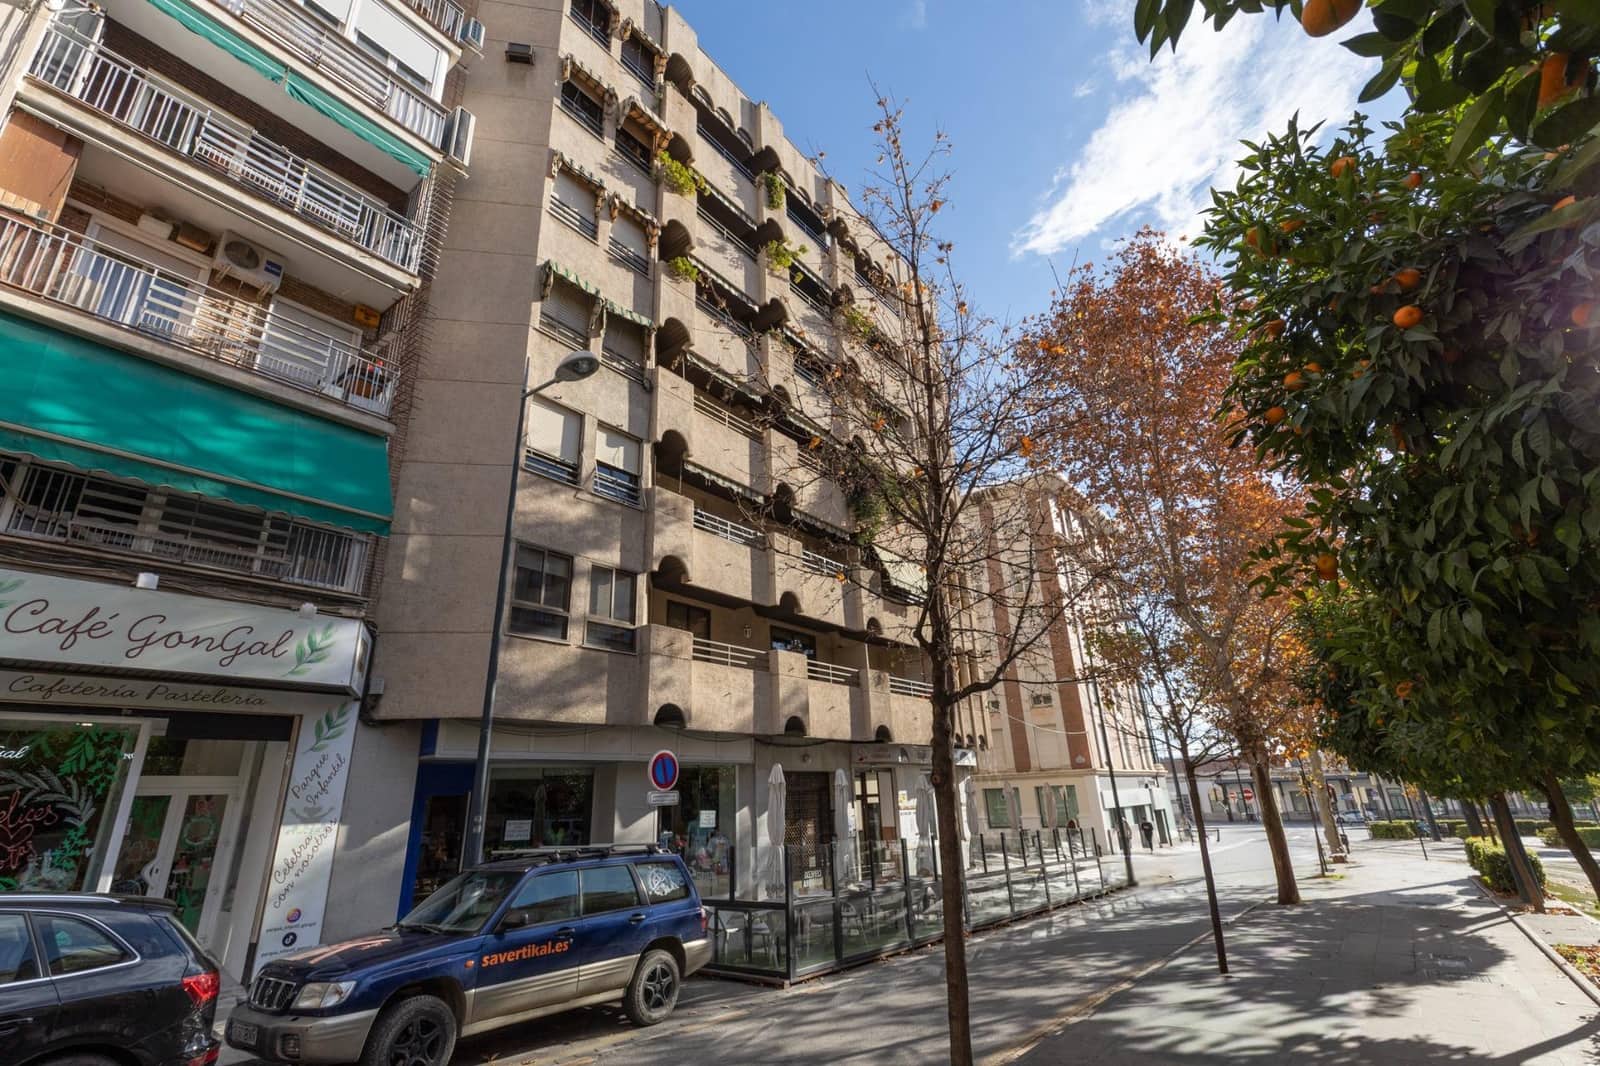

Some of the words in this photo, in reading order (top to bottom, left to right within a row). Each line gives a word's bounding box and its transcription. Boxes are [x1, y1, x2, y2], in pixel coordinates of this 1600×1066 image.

[4, 599, 120, 651] Café
[125, 614, 294, 667] GonGal
[8, 675, 138, 700] Cafetería
[145, 683, 267, 706] Pastelería
[291, 753, 329, 799] Parque
[306, 753, 346, 805] Infantil
[273, 881, 295, 909] con
[294, 818, 338, 878] nosotros
[274, 834, 314, 885] Celebra
[481, 941, 569, 967] savertikal.es
